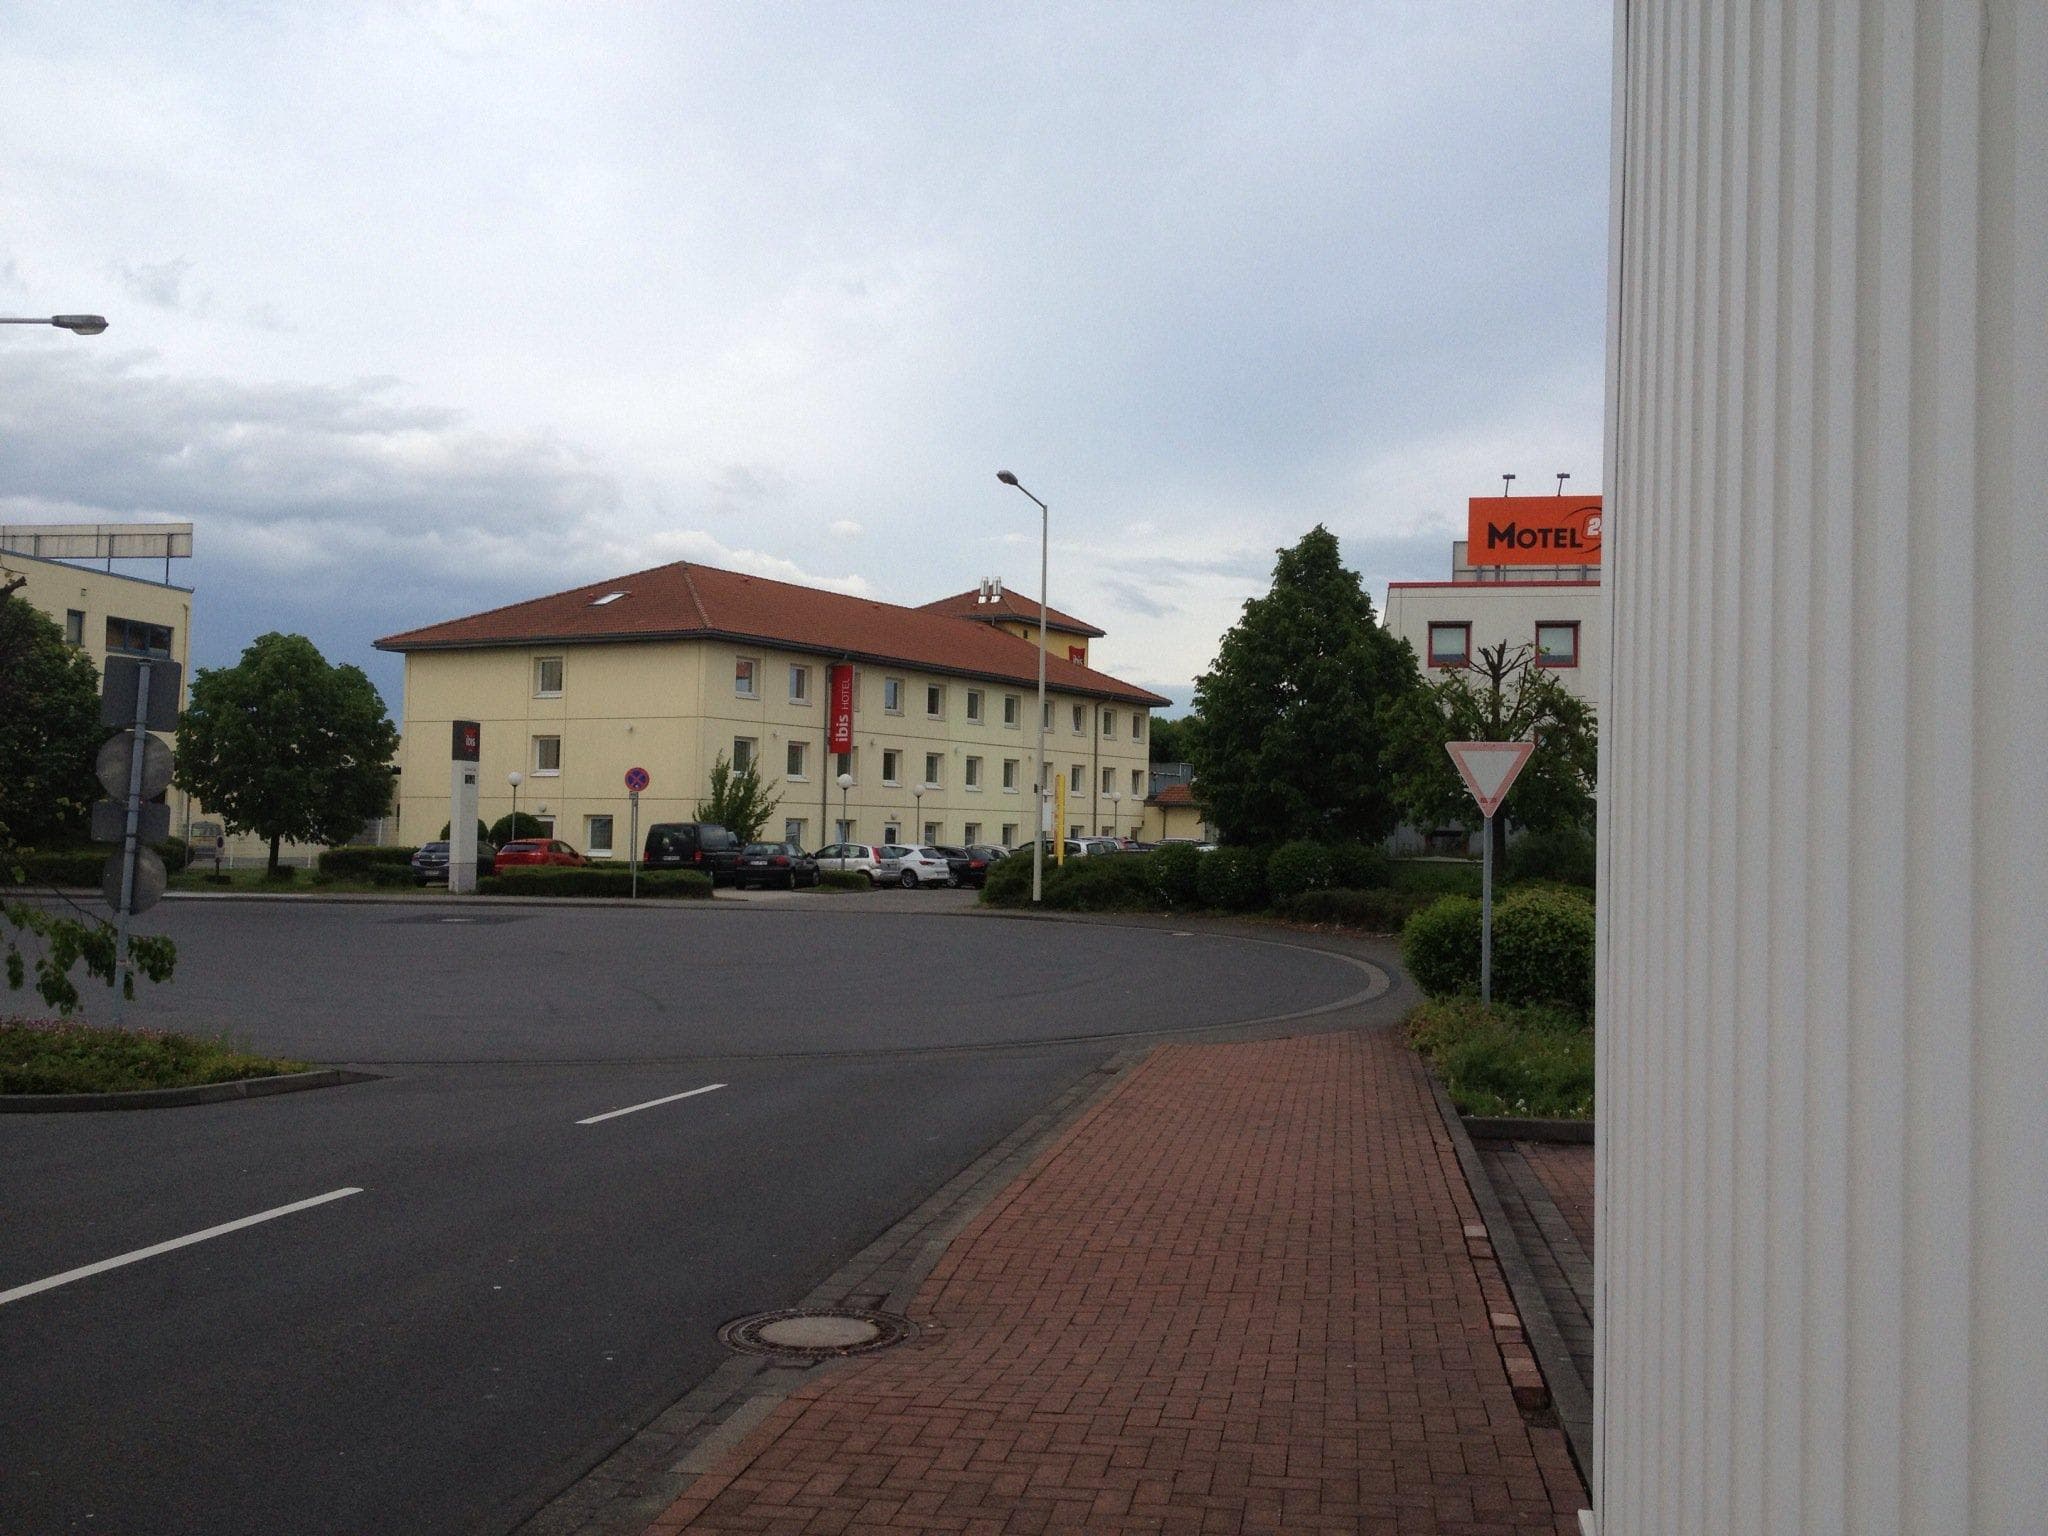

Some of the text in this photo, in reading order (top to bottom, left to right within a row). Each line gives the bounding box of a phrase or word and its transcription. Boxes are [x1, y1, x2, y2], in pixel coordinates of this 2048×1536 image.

[1487, 516, 1602, 549] MOTEL 2
[836, 678, 851, 742] ibis HOTEL
[465, 735, 476, 747] ibis
